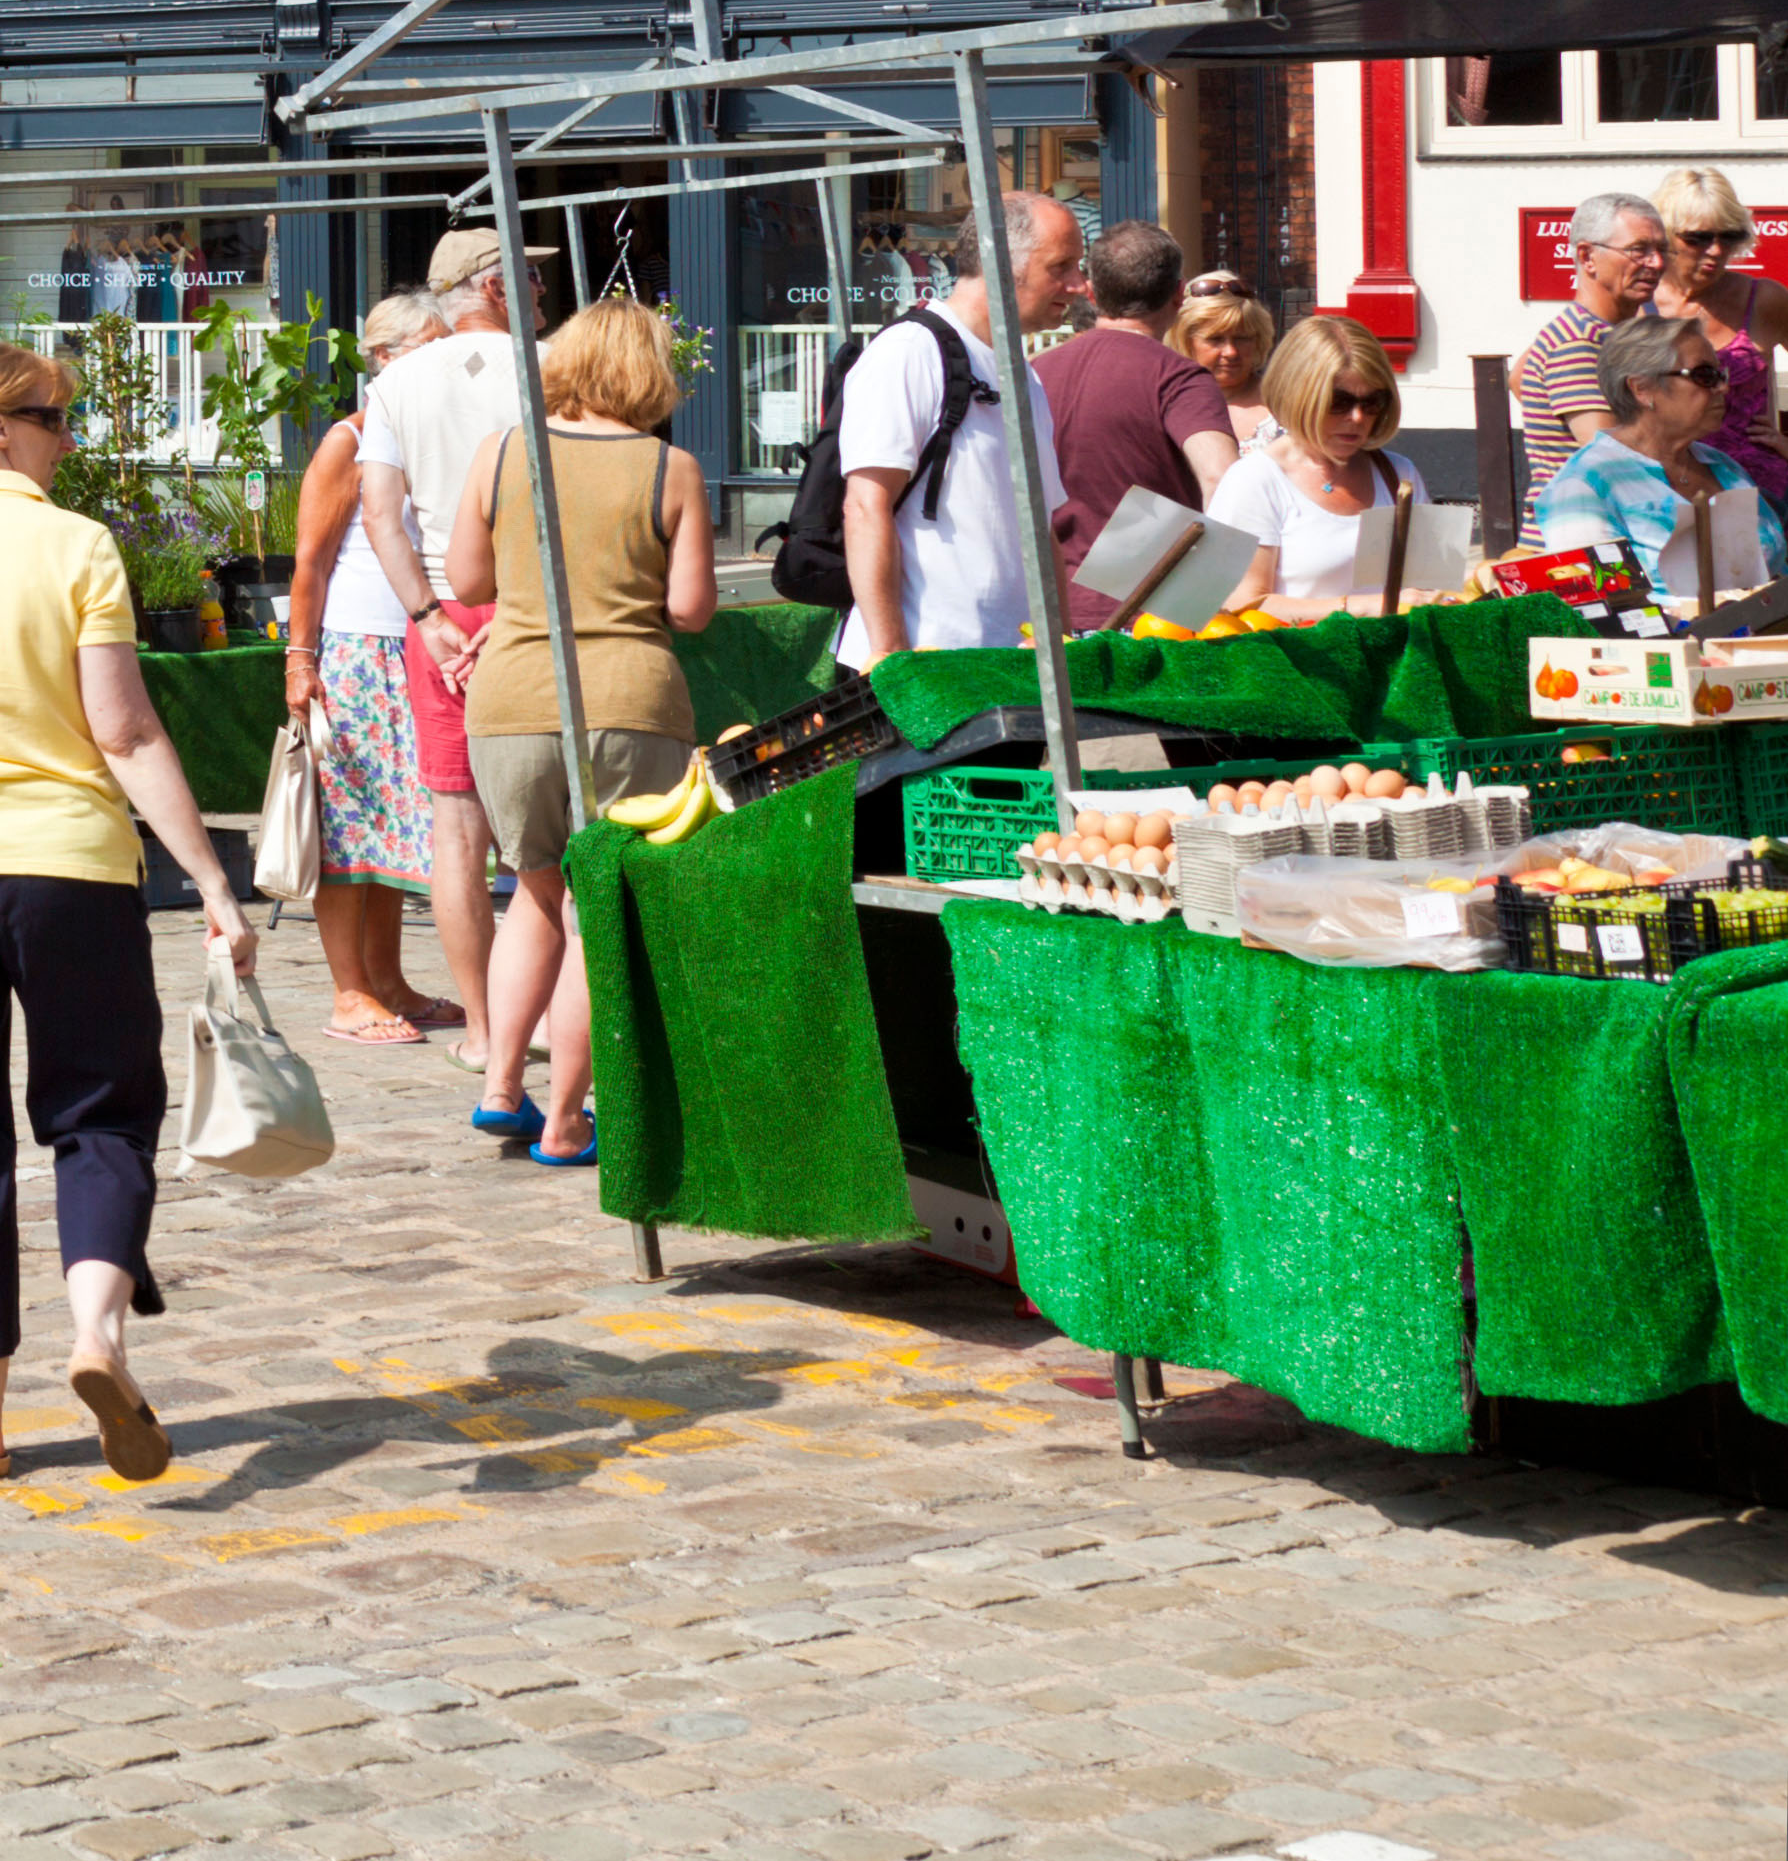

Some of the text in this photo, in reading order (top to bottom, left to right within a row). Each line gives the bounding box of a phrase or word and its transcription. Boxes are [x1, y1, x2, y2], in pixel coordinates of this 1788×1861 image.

[28, 270, 245, 290] CHOICE SHAPE QUALITY
